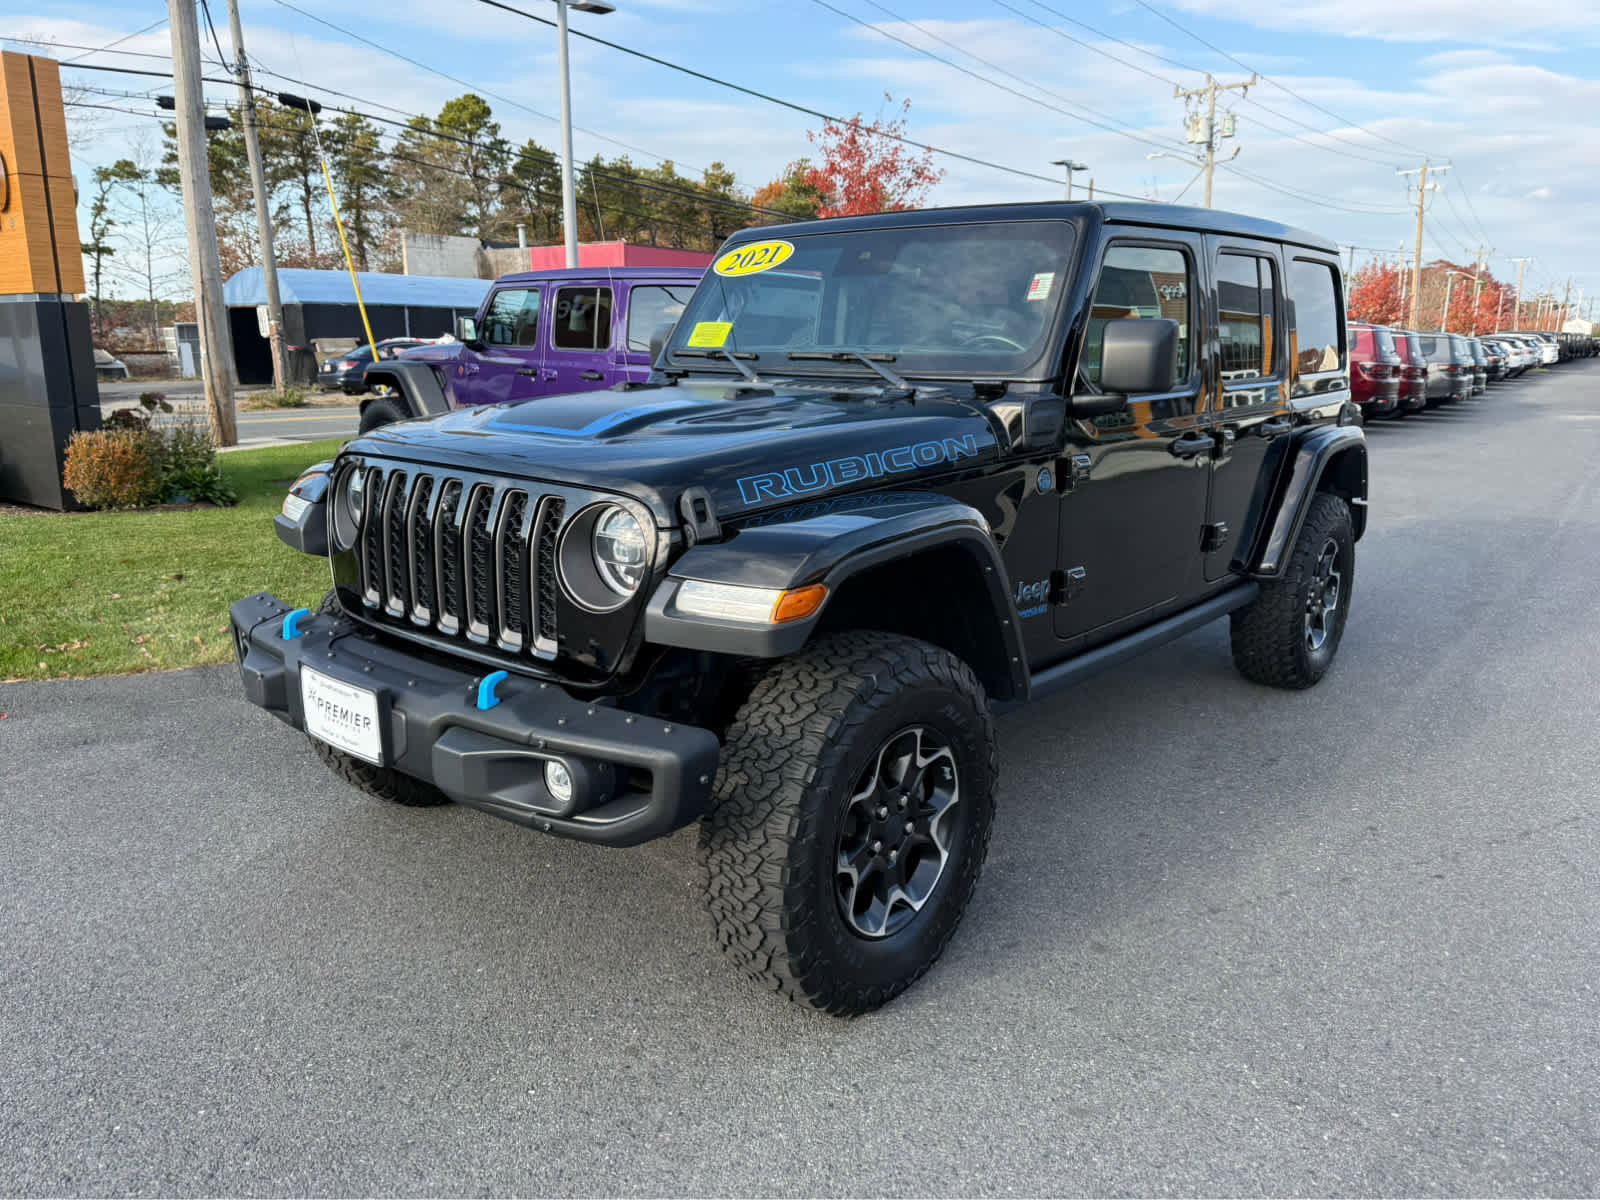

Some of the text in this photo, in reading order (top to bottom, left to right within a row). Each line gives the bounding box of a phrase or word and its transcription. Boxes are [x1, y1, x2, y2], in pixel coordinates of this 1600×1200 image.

[723, 244, 784, 272] 2021
[736, 434, 978, 505] RUBICON
[1016, 580, 1049, 603] Jeep
[317, 697, 371, 730] PREMIER
